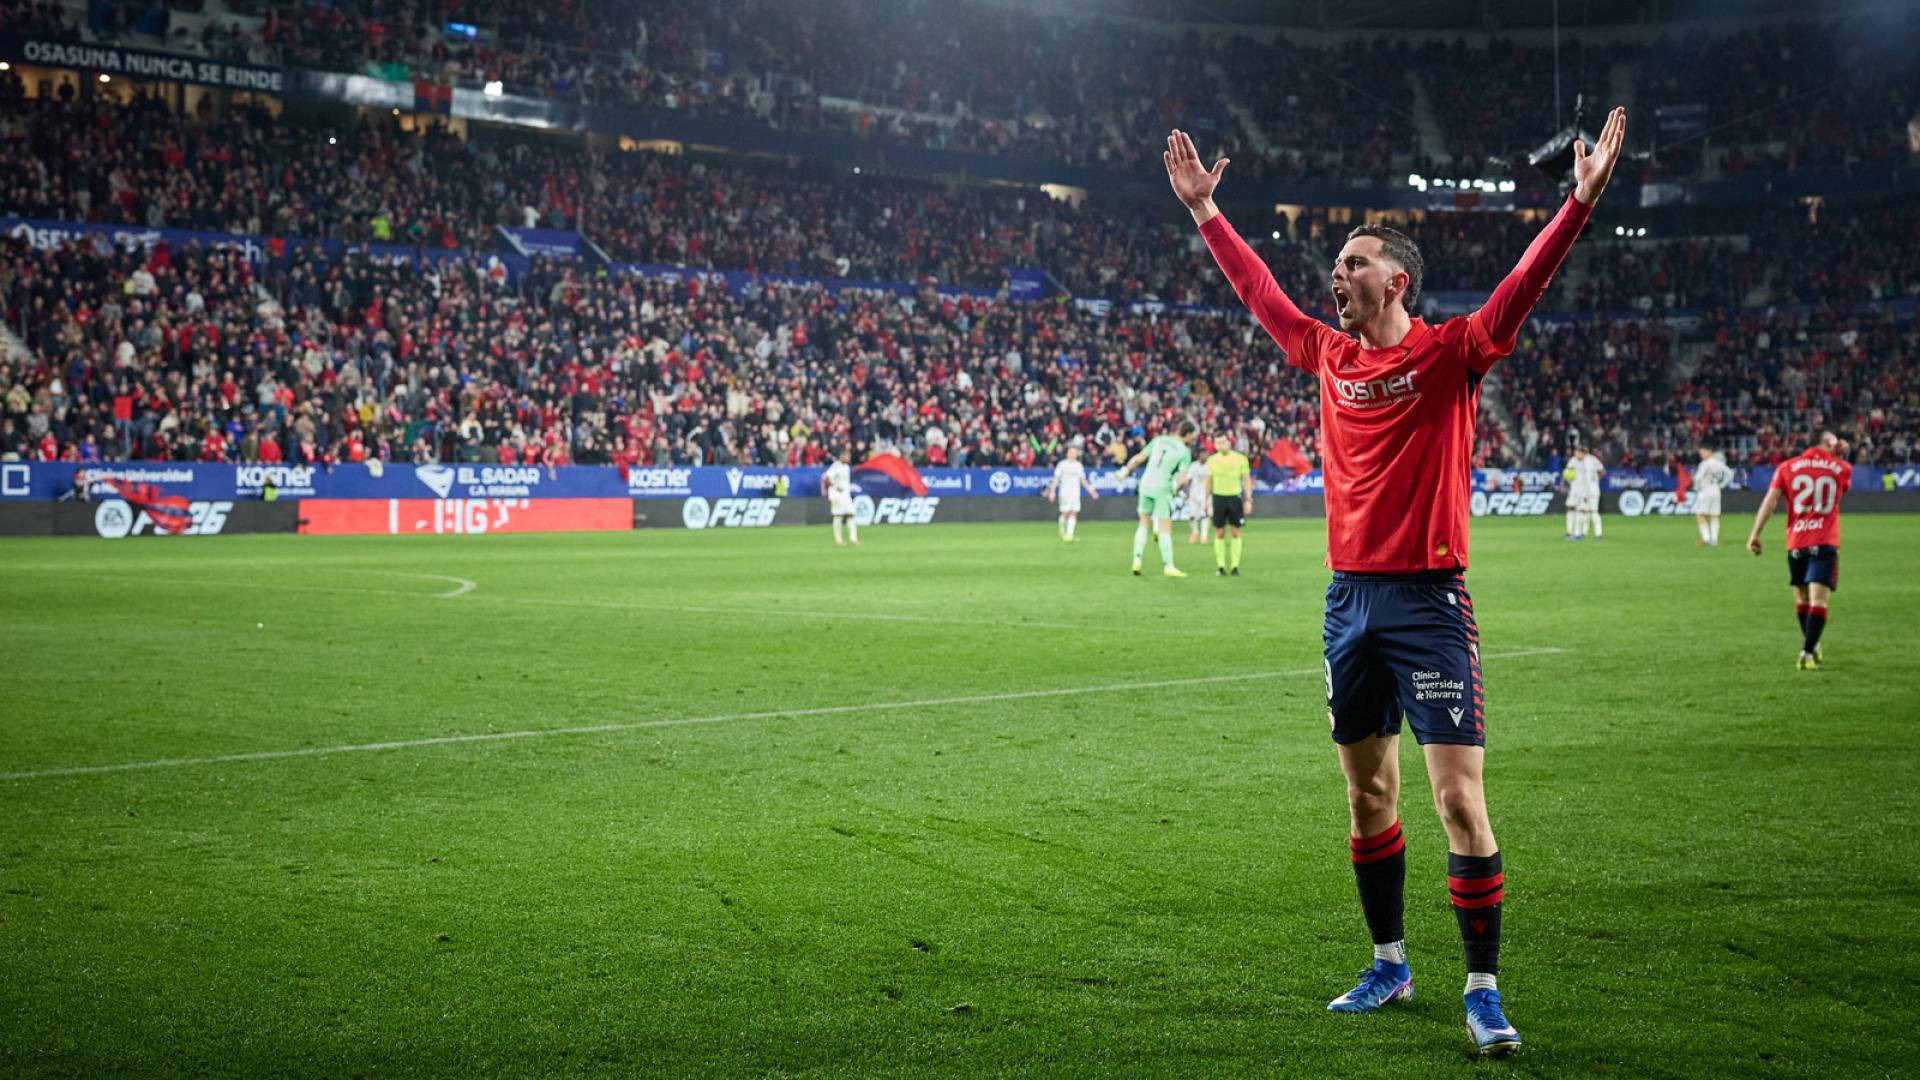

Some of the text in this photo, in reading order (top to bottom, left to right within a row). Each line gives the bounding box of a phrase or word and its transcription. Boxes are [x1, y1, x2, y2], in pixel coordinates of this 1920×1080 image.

[24, 41, 282, 90] OSASUNA NUNCA SE RINDE
[457, 467, 541, 485] EL SADAR
[628, 468, 691, 487] kosner
[1486, 492, 1554, 515] FC26
[1791, 474, 1837, 515] 20
[708, 498, 781, 527] FC26
[873, 497, 940, 524] FC26
[1411, 671, 1440, 682] Clínica
[1415, 690, 1462, 700] de Navarra
